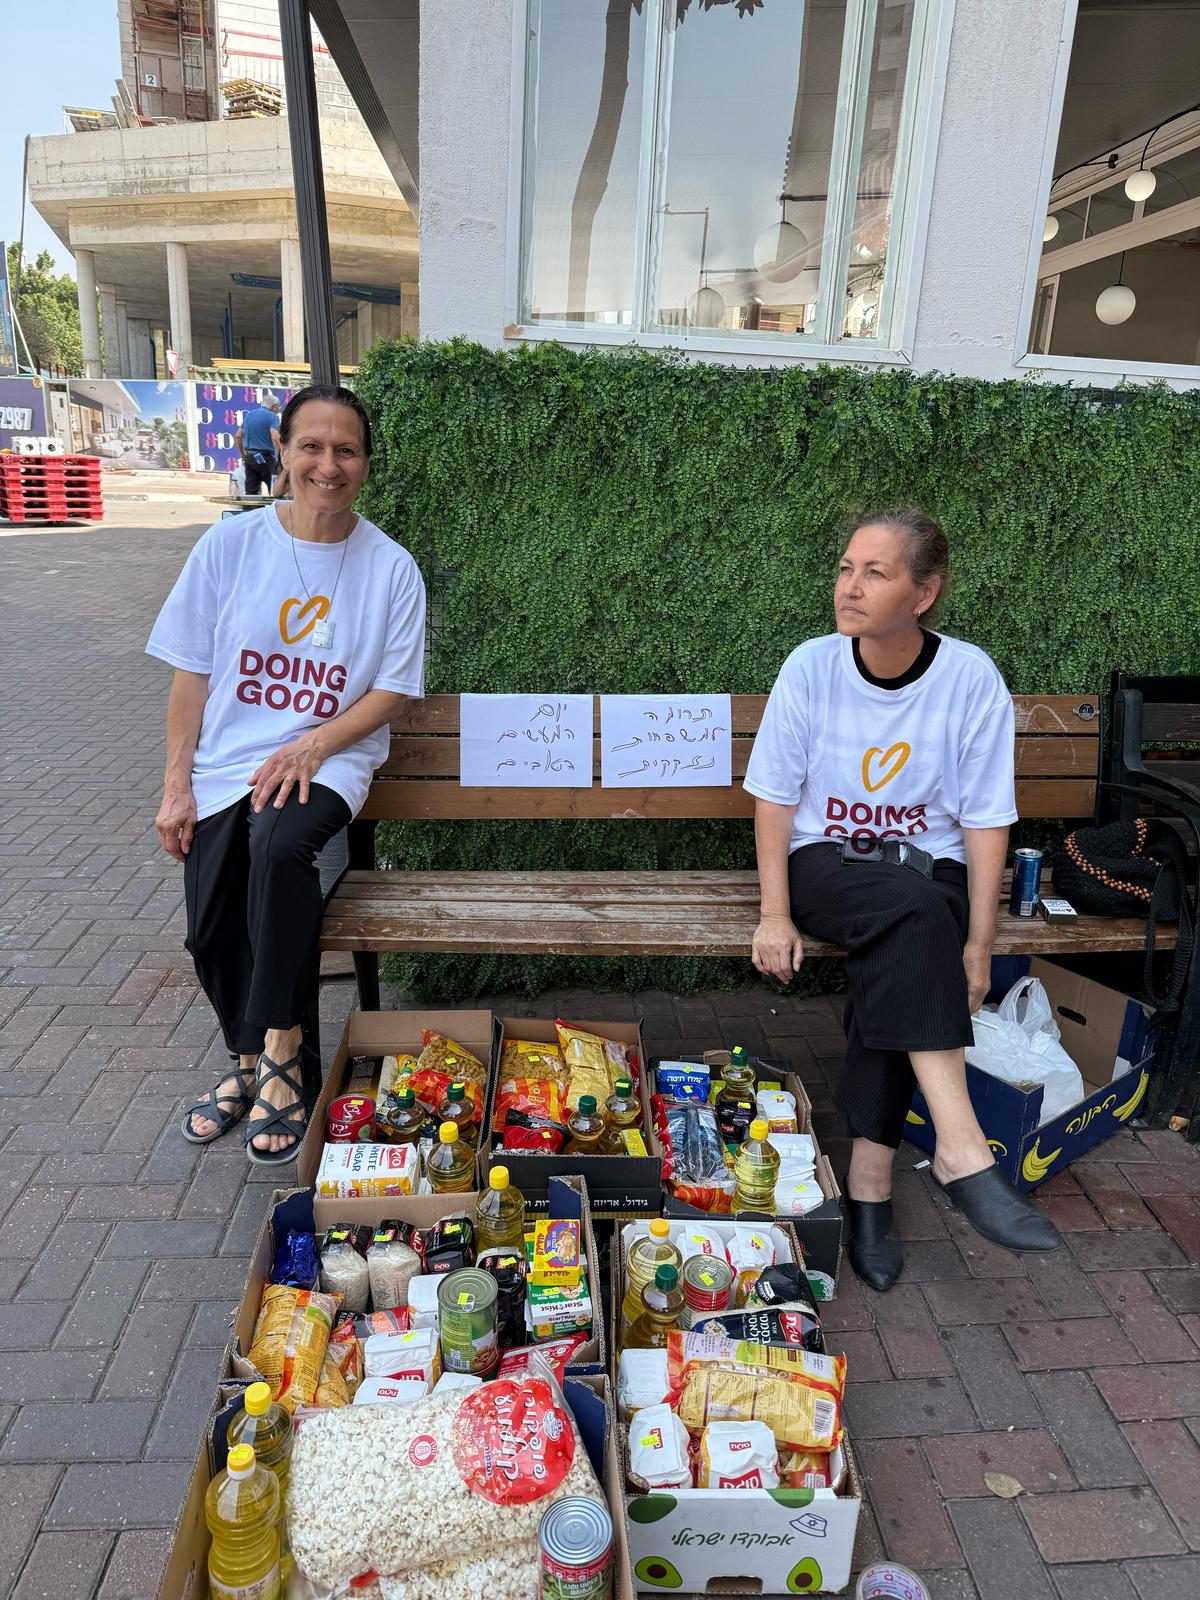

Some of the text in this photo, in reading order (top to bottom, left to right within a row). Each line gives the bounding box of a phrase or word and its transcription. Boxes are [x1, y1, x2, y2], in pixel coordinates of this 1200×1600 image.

[147, 75, 155, 85] 2
[240, 649, 347, 693] DOING
[236, 680, 339, 718] GOOD
[529, 703, 567, 723] יום
[826, 797, 928, 827] DOING
[687, 1076, 704, 1084] קמח
[352, 1145, 367, 1172] SUGAR
[367, 1146, 381, 1171] WHITE
[593, 1199, 620, 1207] אריזה
[623, 1196, 649, 1207] גידול,
[747, 1314, 760, 1344] קלאסי
[760, 1313, 771, 1344] בסמטי
[494, 1394, 528, 1481] קולנוע
[521, 1389, 546, 1480] פופקורן
[671, 1527, 795, 1549] אבוקדו ישראלי
